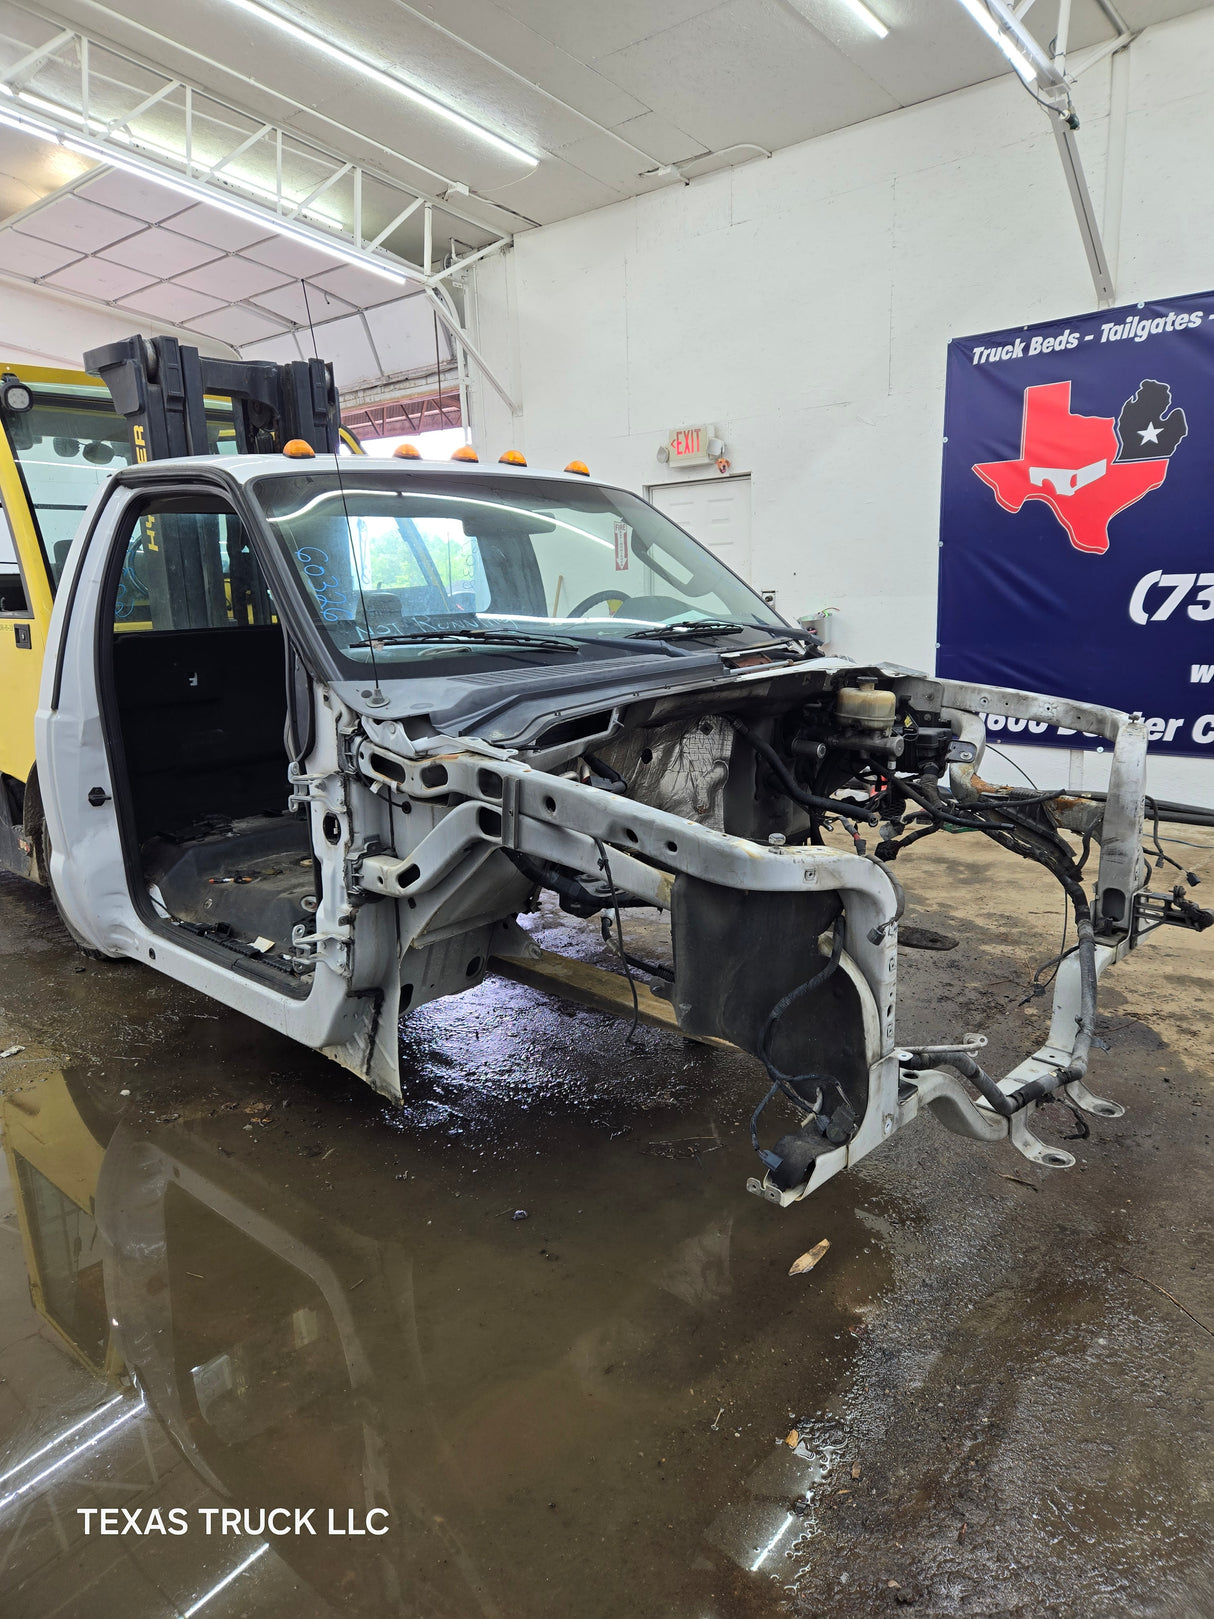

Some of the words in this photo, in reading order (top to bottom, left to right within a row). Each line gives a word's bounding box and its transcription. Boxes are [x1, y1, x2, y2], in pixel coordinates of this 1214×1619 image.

[972, 338, 1026, 365] Truck
[1028, 329, 1080, 356] Beds
[1100, 310, 1204, 343] Tailgates
[677, 428, 701, 456] EXIT
[295, 546, 353, 622] 60326
[1129, 569, 1214, 625] (73
